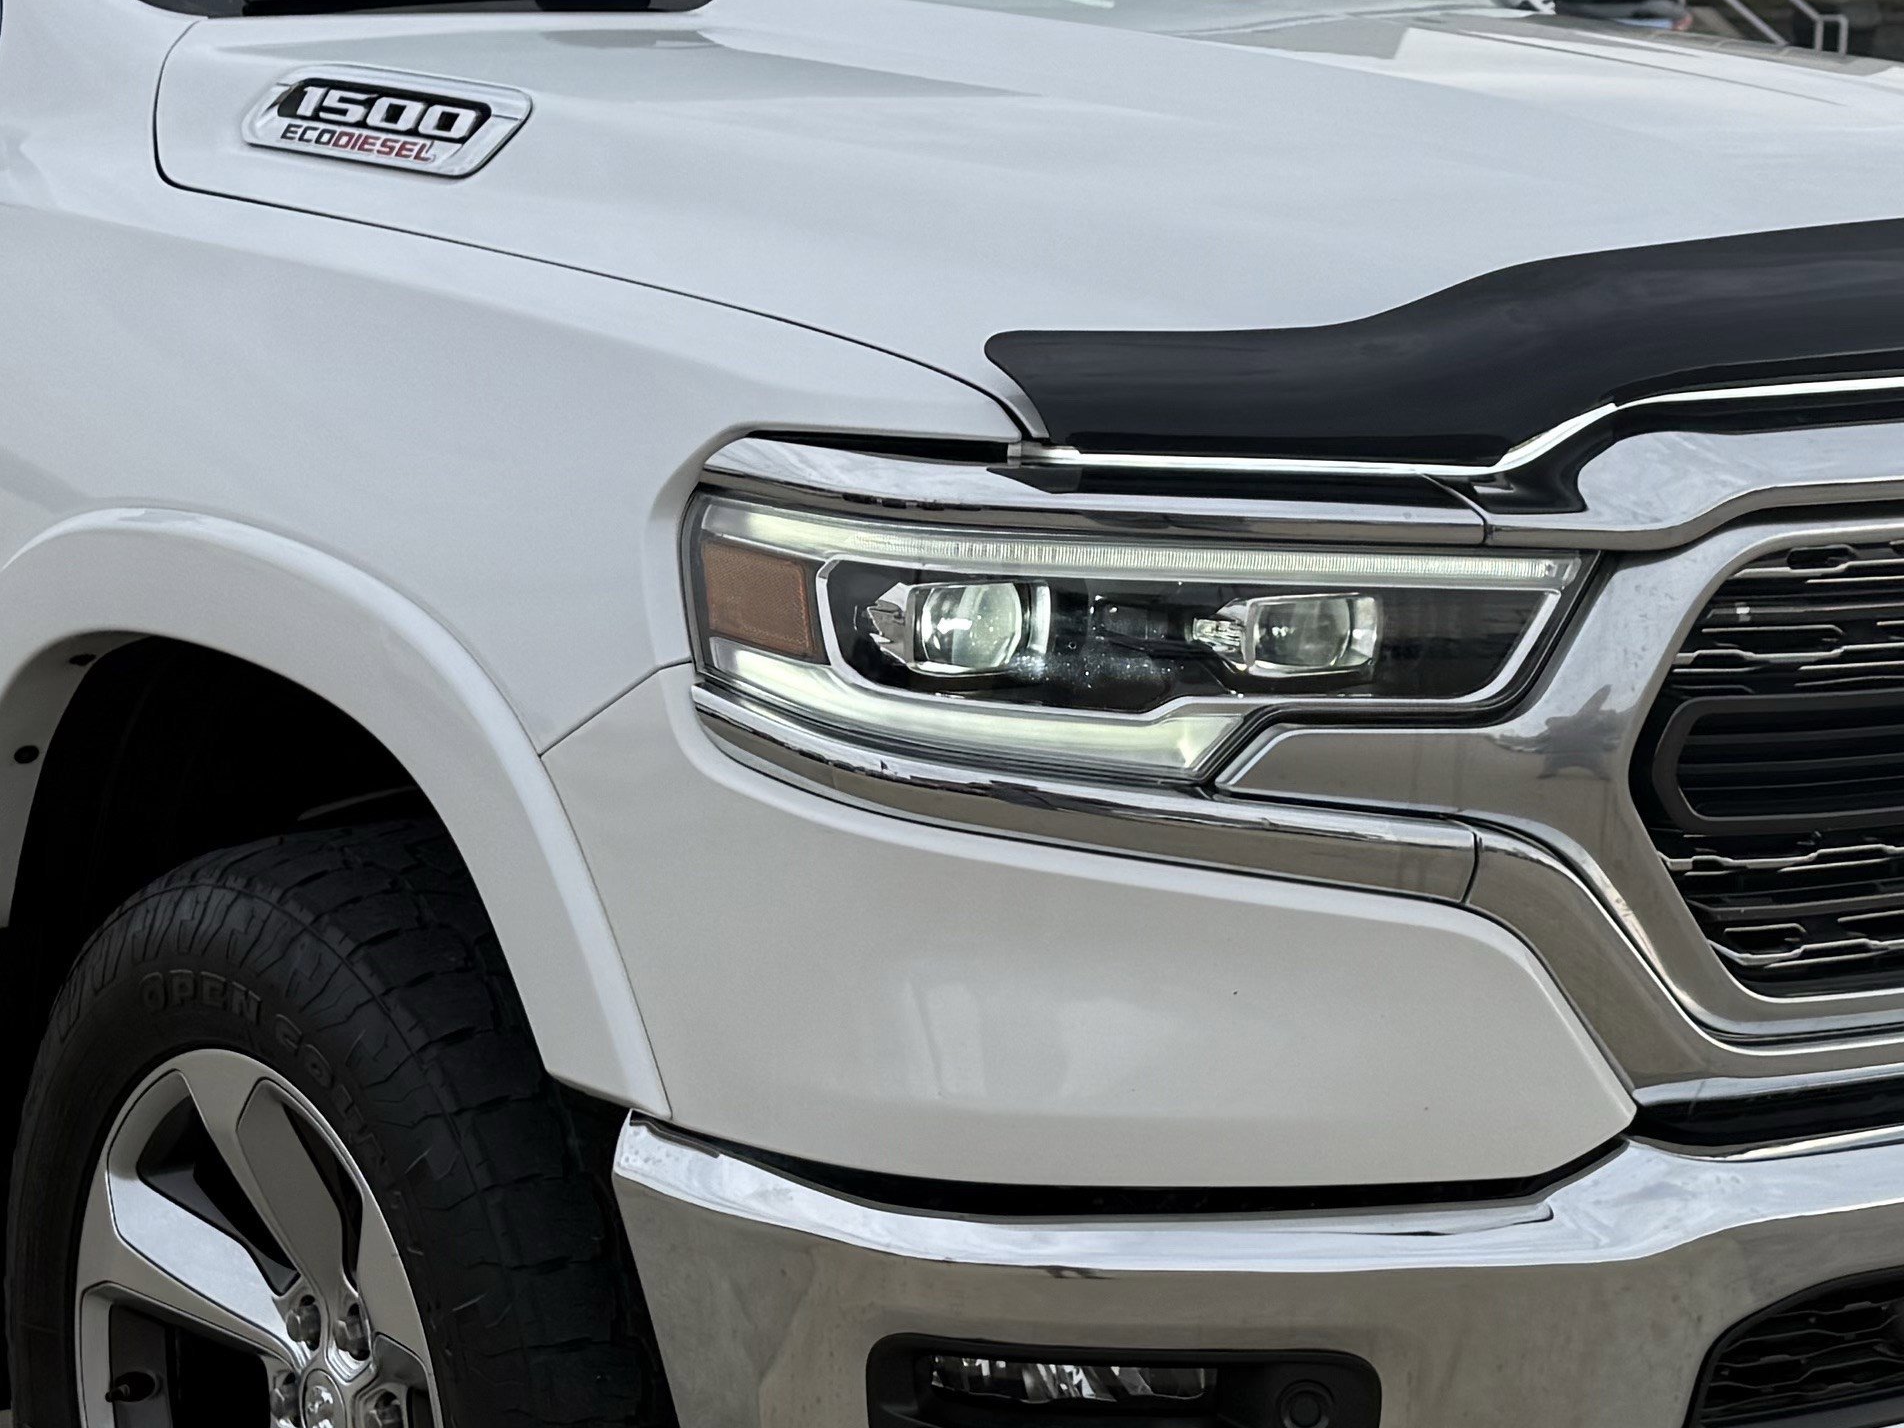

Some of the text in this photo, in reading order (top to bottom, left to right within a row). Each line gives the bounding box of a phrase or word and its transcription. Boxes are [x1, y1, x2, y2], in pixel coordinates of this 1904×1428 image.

[295, 84, 480, 140] 1500
[280, 124, 435, 164] ECODIESEL
[139, 968, 263, 1025] OPEN
